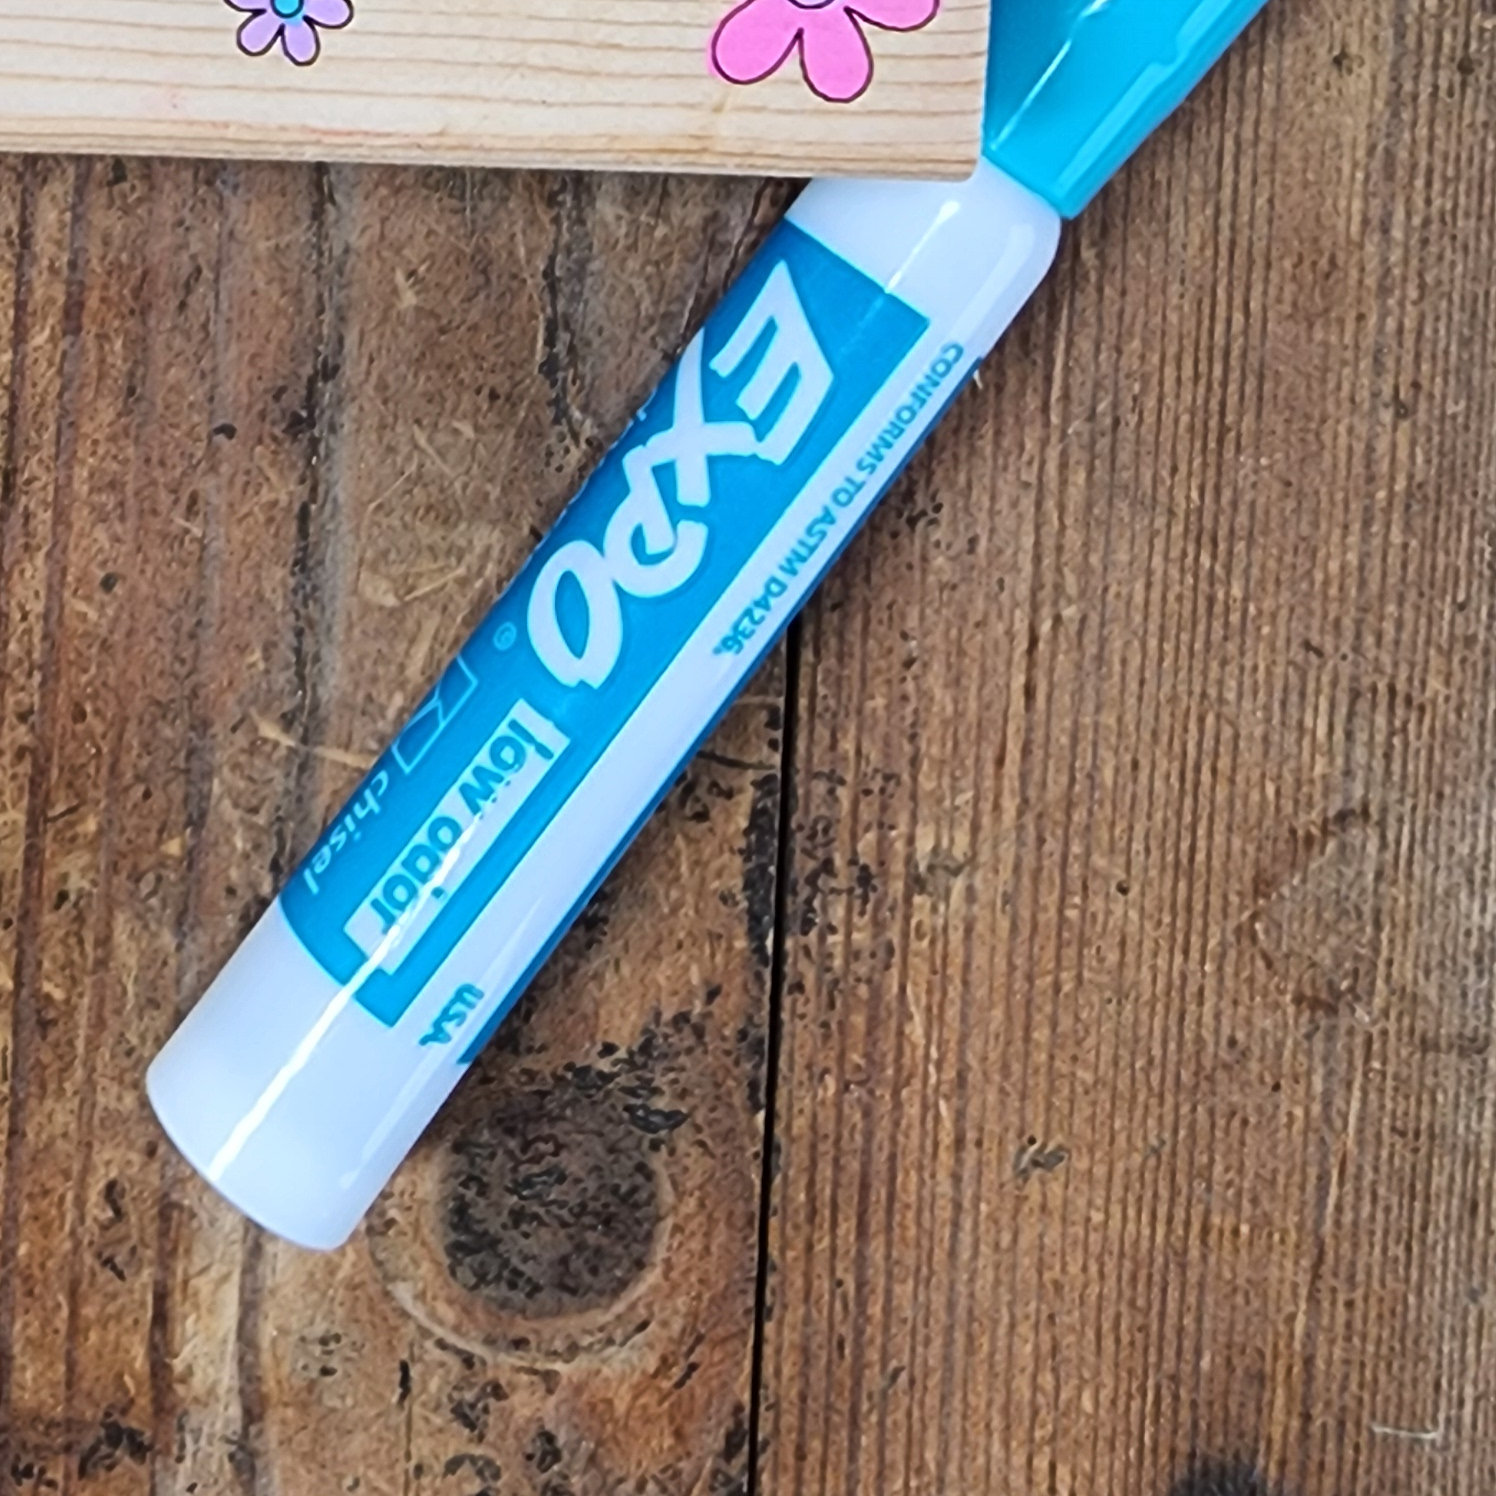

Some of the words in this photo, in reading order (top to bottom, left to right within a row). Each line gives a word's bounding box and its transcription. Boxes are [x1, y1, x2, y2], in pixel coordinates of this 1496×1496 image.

[856, 342, 964, 475] CONFORMS
[527, 260, 834, 689] EXPO
[831, 476, 866, 508] TO
[778, 505, 837, 578] ASTM
[711, 578, 788, 656] D4236.
[458, 718, 554, 820] low
[303, 770, 390, 895] chisel
[370, 816, 463, 935] odor
